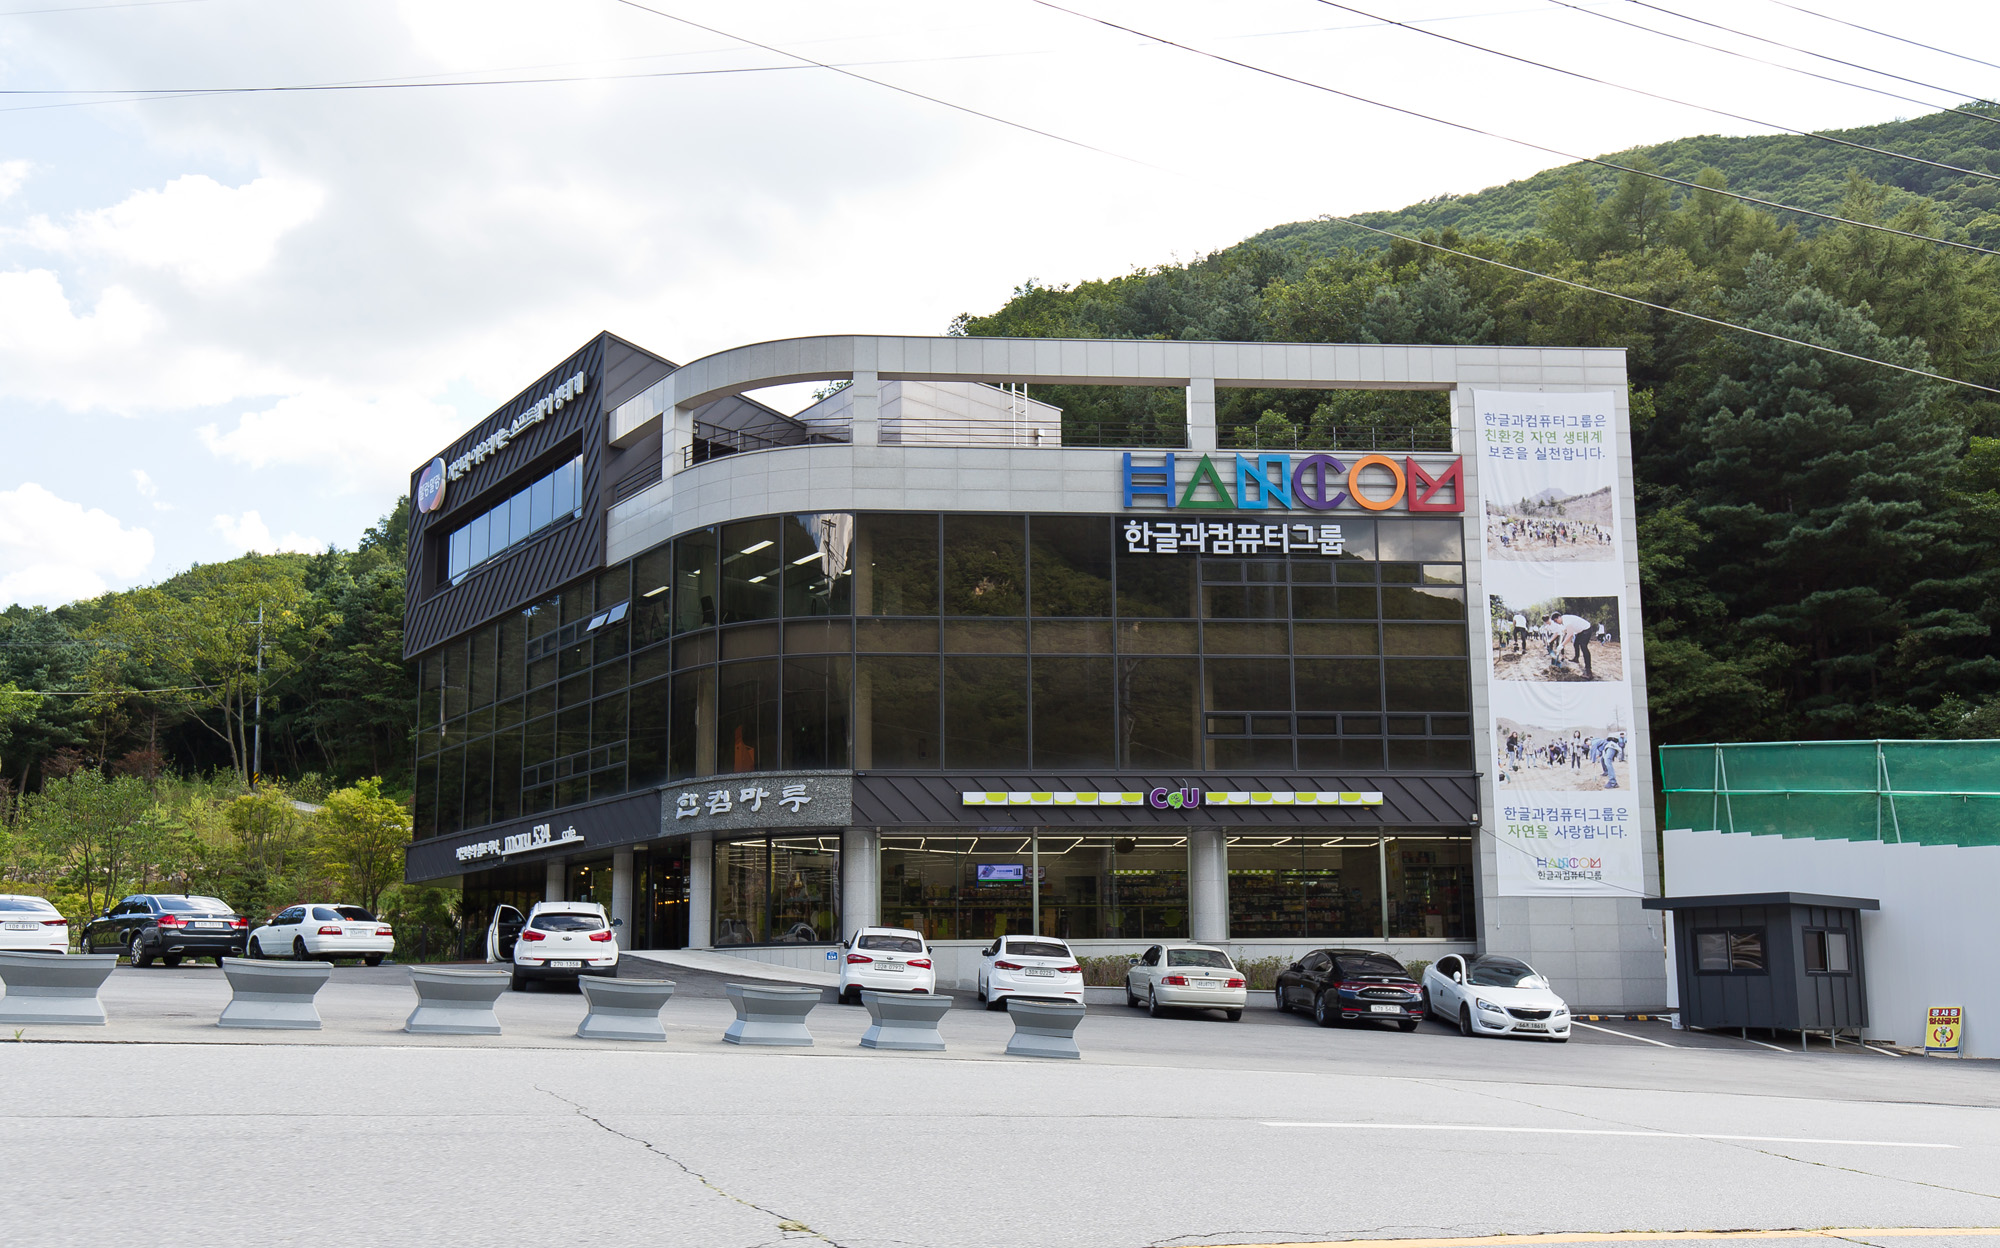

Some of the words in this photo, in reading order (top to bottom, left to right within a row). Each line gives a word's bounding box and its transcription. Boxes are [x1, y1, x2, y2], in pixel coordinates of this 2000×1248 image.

[510, 393, 553, 438] 소프트웨어
[554, 371, 584, 410] 생태계
[1484, 412, 1606, 428] 한글과컴퓨터그룹은
[1485, 429, 1524, 444] 친환경
[1531, 430, 1557, 444] 자연
[1563, 430, 1602, 444] 생태계
[1488, 446, 1528, 460] 보존을
[1534, 446, 1605, 461] 실천합니다.
[1123, 452, 1465, 512] HANCOM
[1124, 520, 1346, 555] 한글과컴퓨터그룹
[676, 784, 812, 820] 한컴마루
[1150, 787, 1199, 809] CU
[1504, 806, 1628, 822] 한글과컴퓨터그룹은
[533, 824, 551, 845] 534
[1508, 824, 1549, 839] 자연을
[1554, 825, 1628, 839] 사랑합니다.
[1536, 857, 1601, 868] HANCOM
[1537, 870, 1602, 880] 한글과컴퓨터그룹
